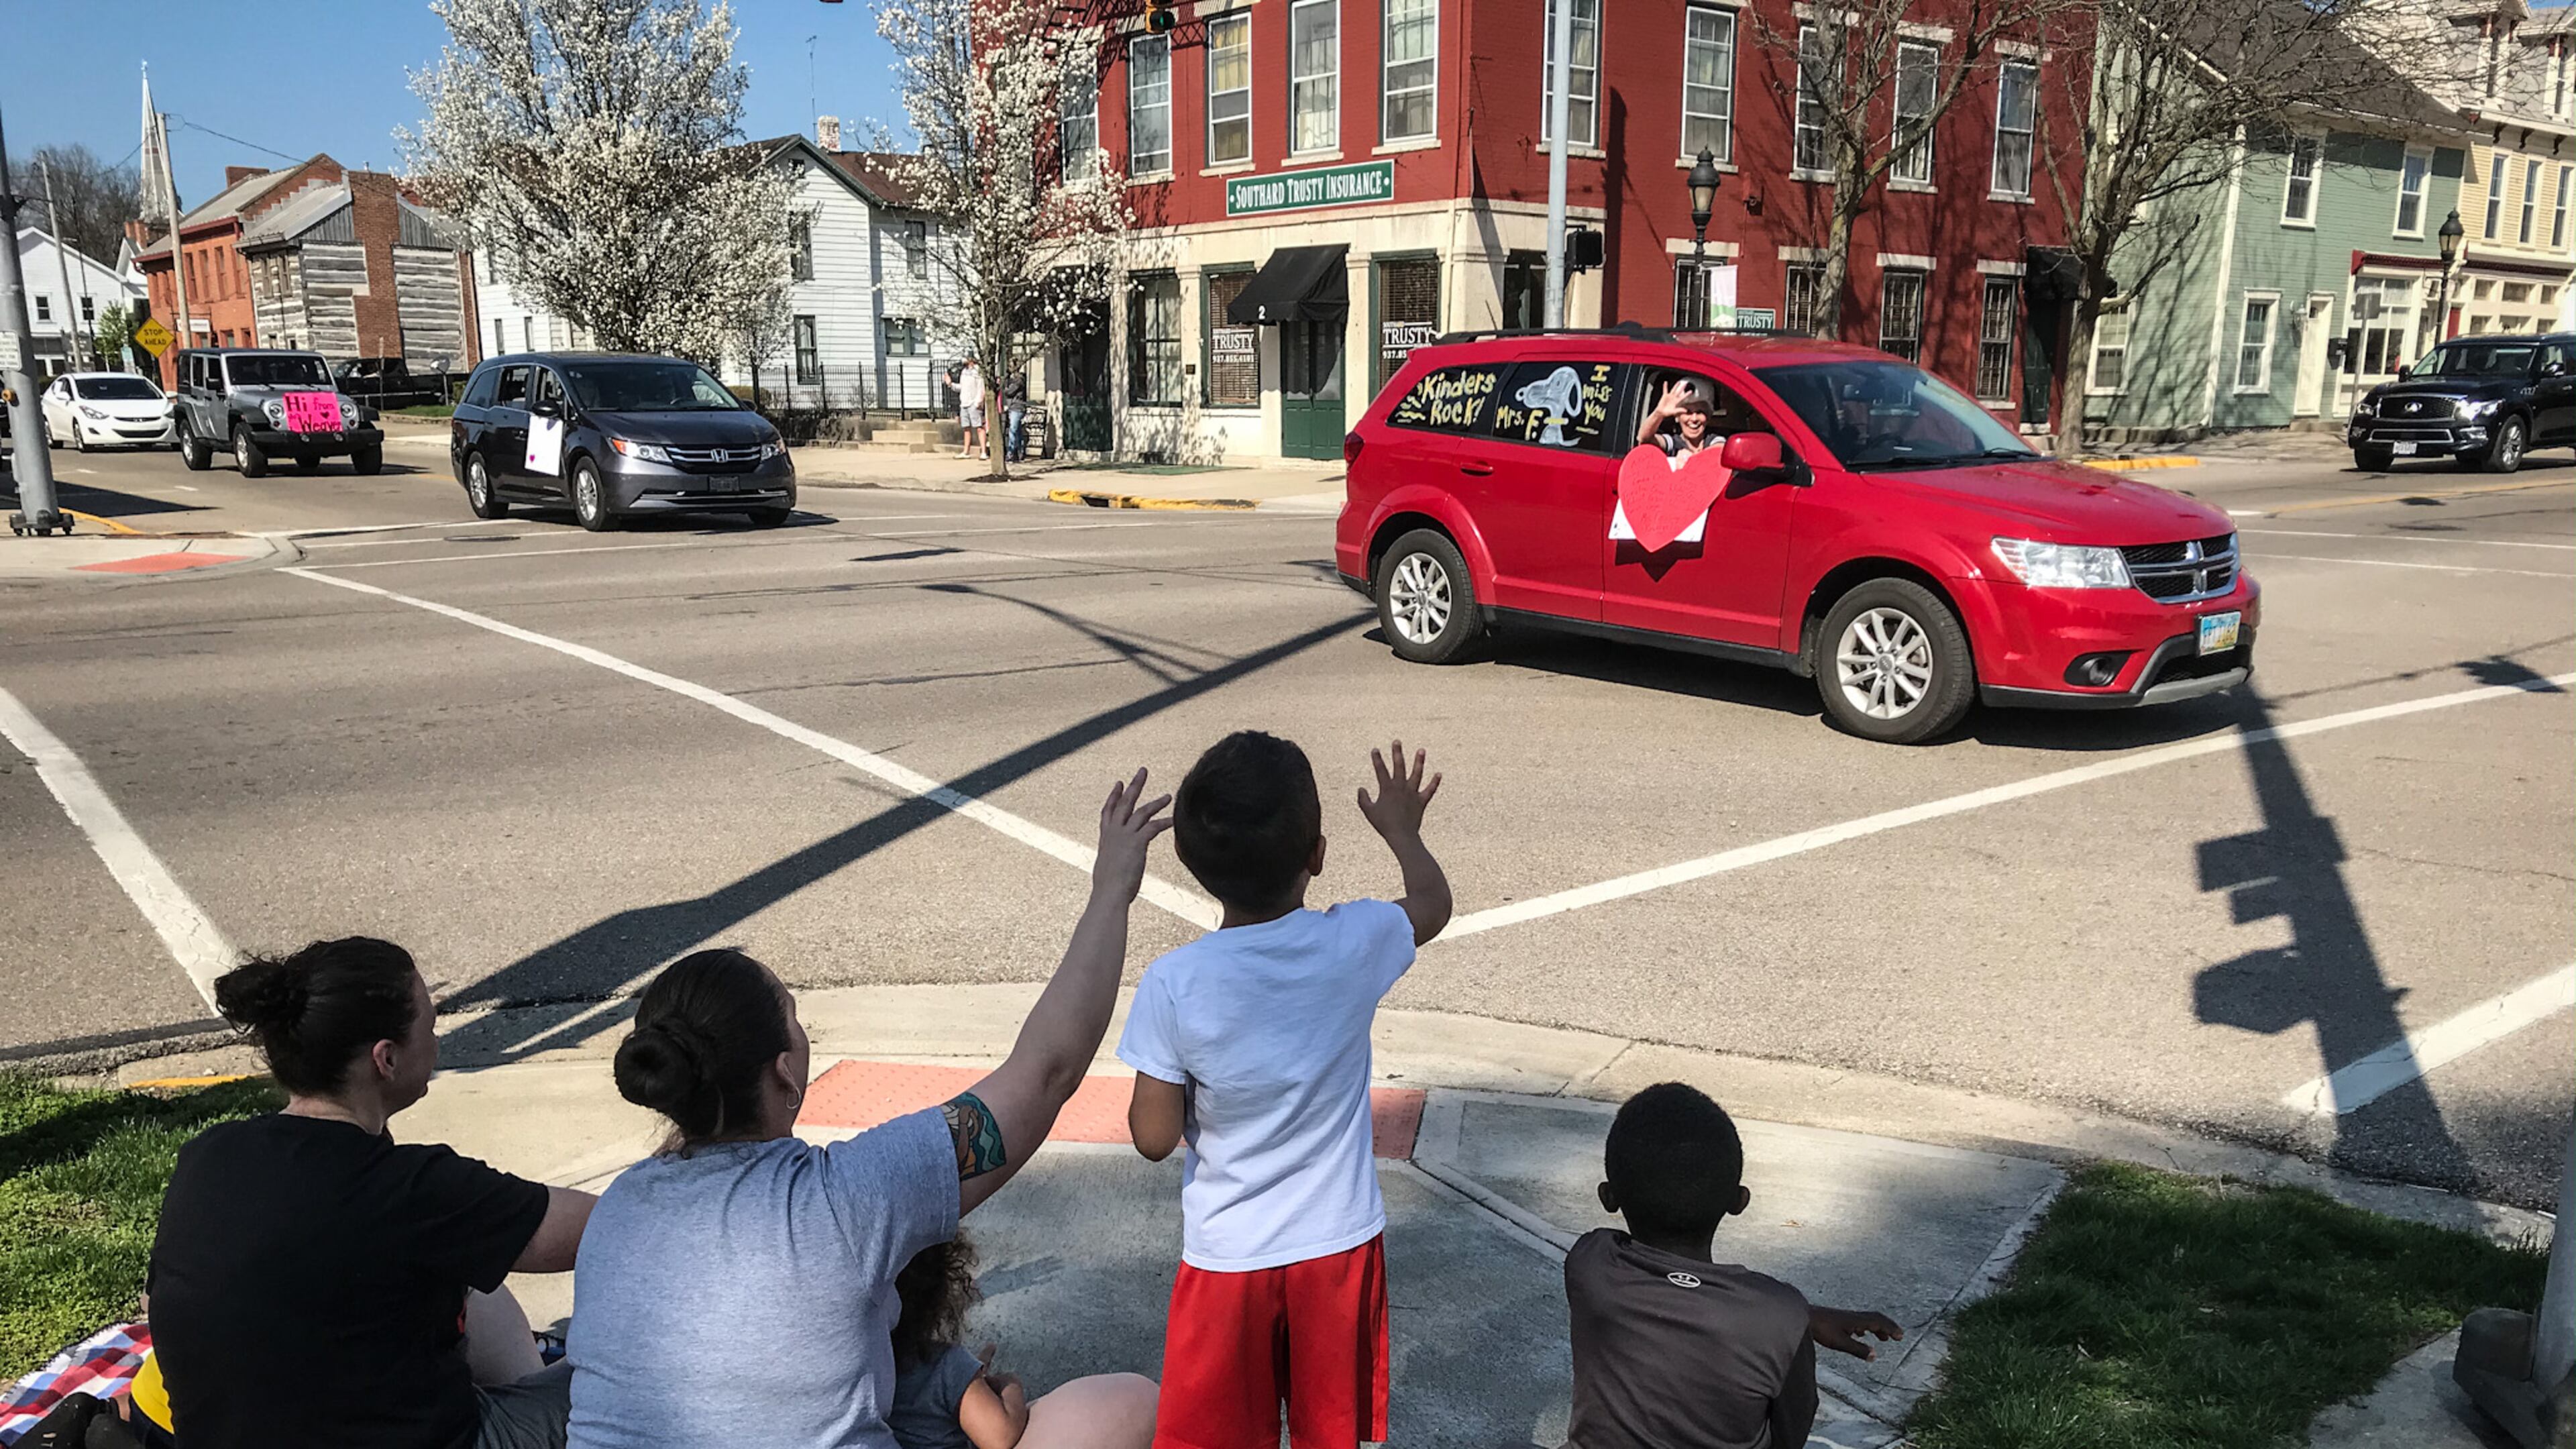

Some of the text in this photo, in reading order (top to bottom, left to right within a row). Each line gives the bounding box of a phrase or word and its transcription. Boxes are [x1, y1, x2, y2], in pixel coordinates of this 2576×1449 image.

[1236, 170, 1383, 209] SOUTHARD TRUSTY INSURANCE
[1258, 305, 1266, 320] 2
[1738, 315, 1773, 329] TRUSTY
[1212, 333, 1254, 350] TRUSTY
[1383, 327, 1433, 345] TRUSTY
[1590, 364, 1611, 382] I
[1421, 370, 1497, 404] Kinders
[1582, 383, 1613, 402] miss
[285, 396, 335, 412] Hi from
[1495, 405, 1544, 441] Mrs. F.
